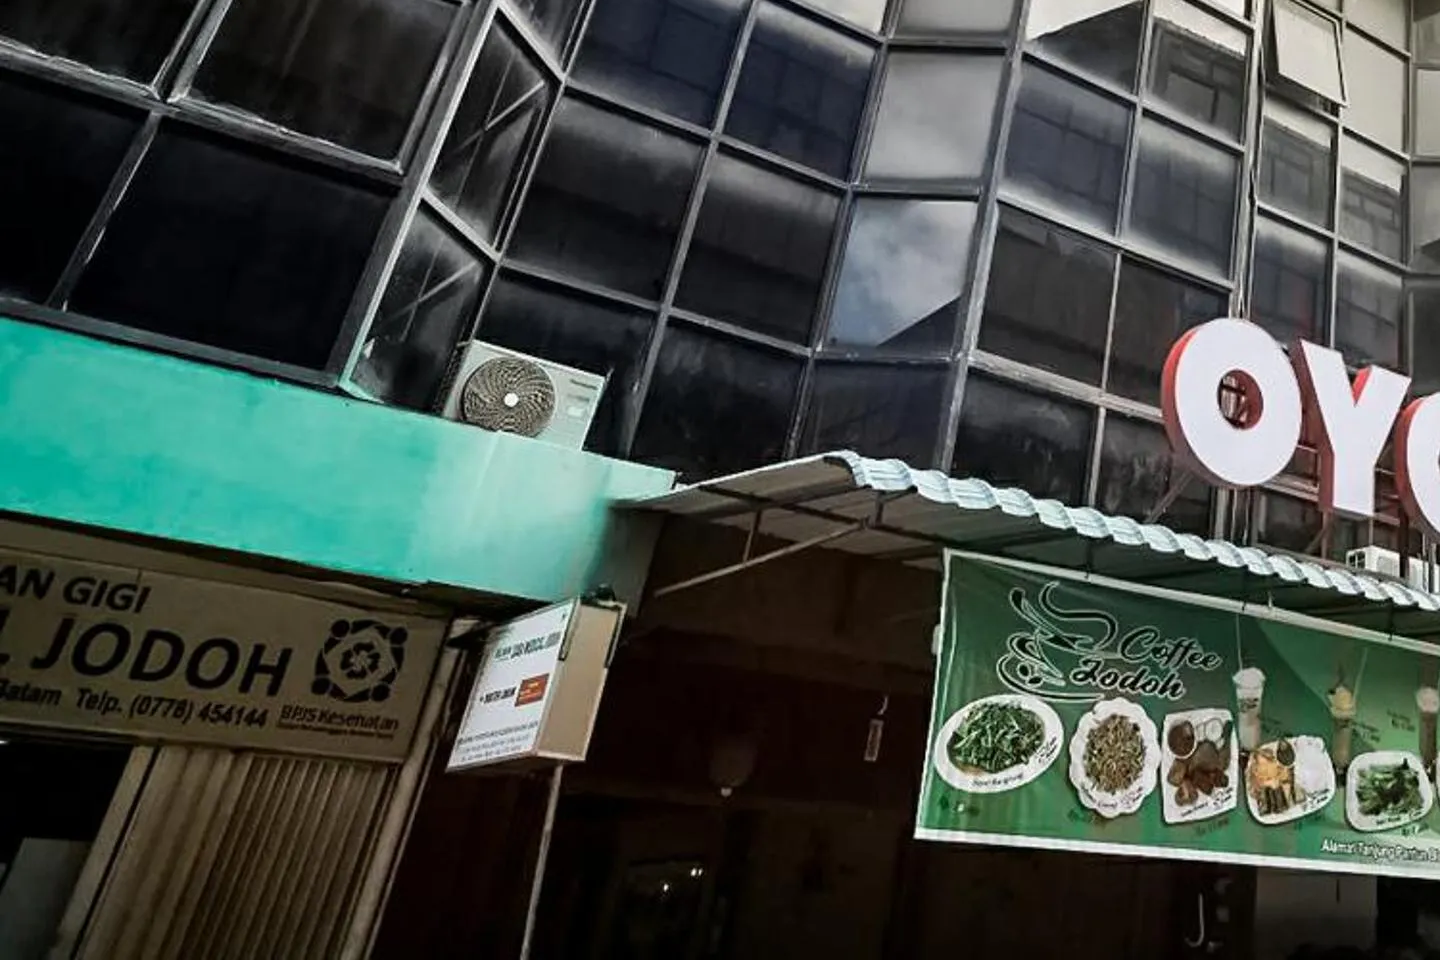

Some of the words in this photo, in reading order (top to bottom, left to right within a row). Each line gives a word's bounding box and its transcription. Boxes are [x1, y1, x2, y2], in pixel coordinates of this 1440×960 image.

[63, 576, 152, 613] GIGI
[30, 618, 293, 697] JODOH
[1119, 627, 1222, 671] Coffee
[1070, 657, 1187, 700] Jodoh
[76, 688, 122, 716] Telp.
[129, 694, 194, 725] (0778)
[198, 701, 269, 728] 454144
[281, 704, 317, 723] BPJS
